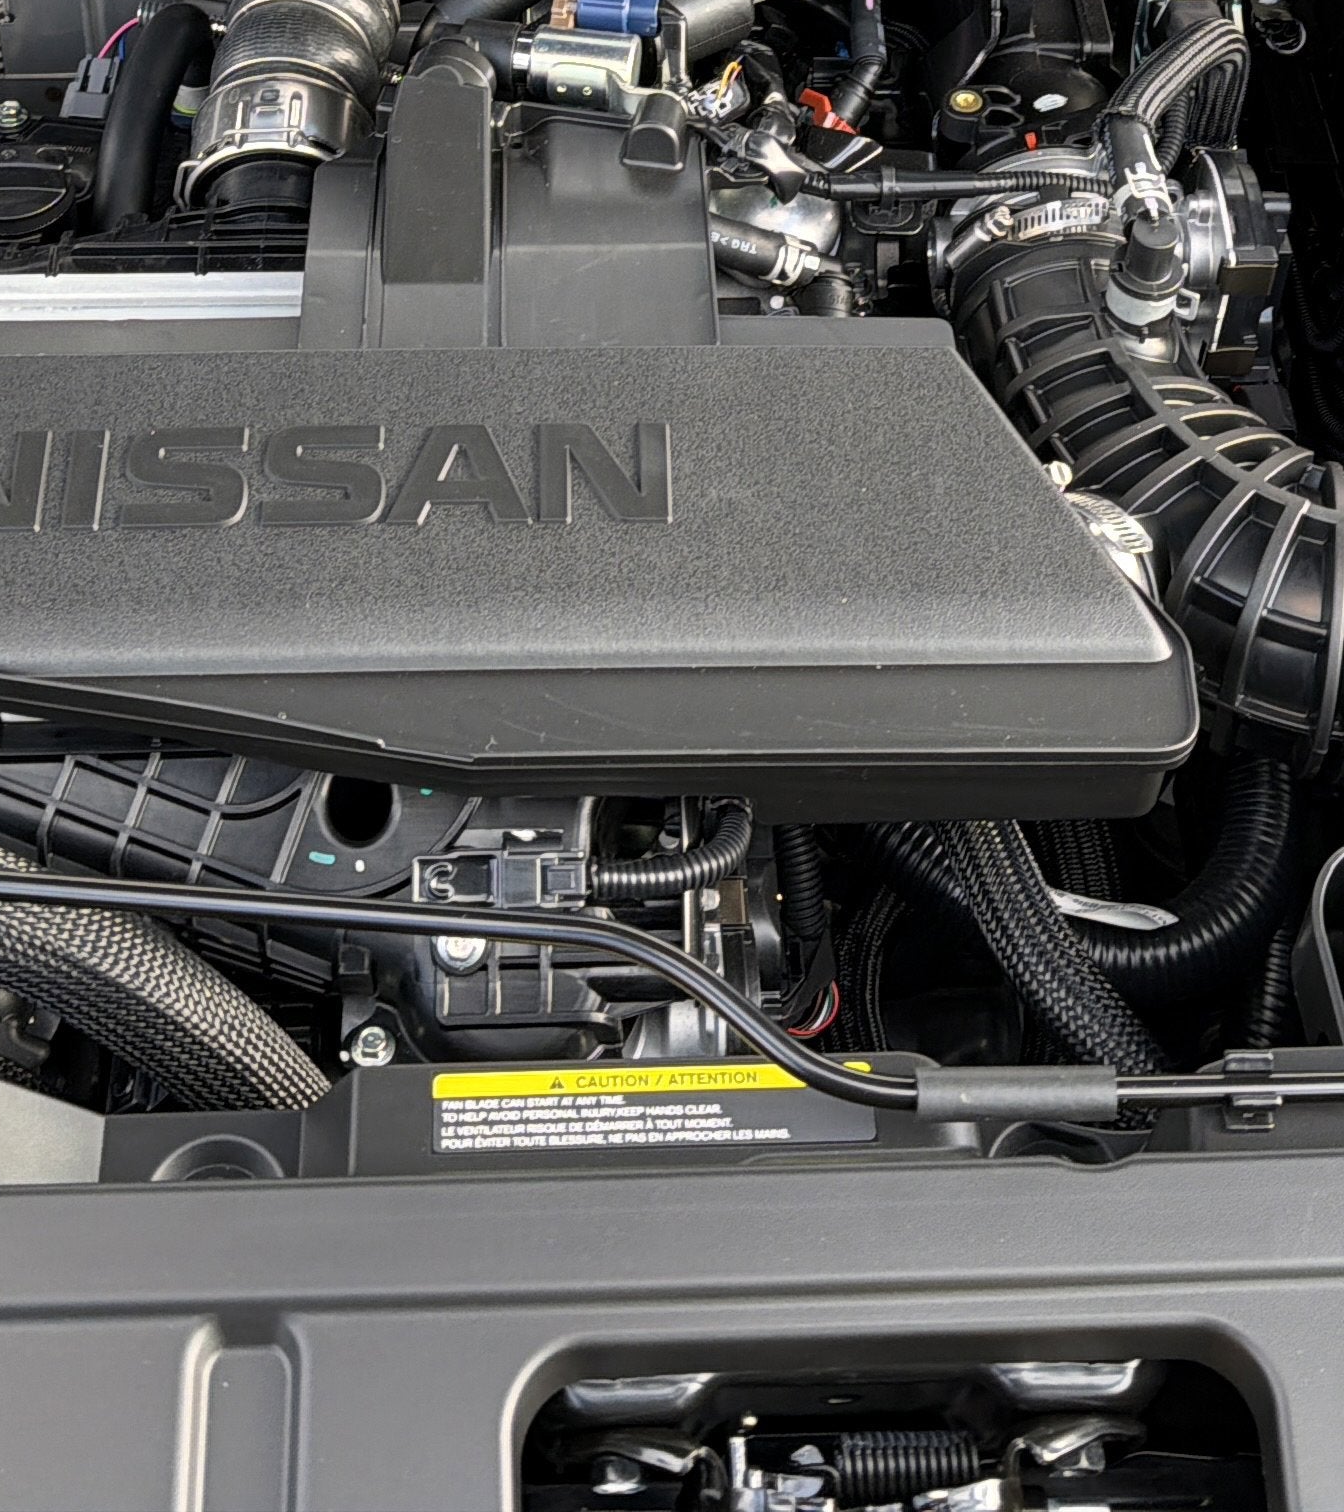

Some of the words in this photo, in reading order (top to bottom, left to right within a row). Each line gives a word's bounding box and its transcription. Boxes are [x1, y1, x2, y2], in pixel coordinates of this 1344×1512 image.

[575, 1074, 650, 1089] CAUTION
[668, 1071, 759, 1086] ATTENTION
[441, 1101, 464, 1111] FAN
[464, 1099, 500, 1110] BLADE
[500, 1098, 525, 1109] CAN
[525, 1097, 560, 1108] START
[560, 1097, 574, 1107] AT
[575, 1096, 599, 1106] ANY
[441, 1112, 458, 1123] TO
[458, 1111, 488, 1122] HELP
[488, 1110, 521, 1121] AVOID
[522, 1109, 580, 1120] PERSONAL
[646, 1104, 684, 1116] HANDS
[685, 1103, 724, 1115] CLEAR.
[441, 1126, 456, 1137] LE
[456, 1124, 526, 1137] VENTILATEUR
[526, 1122, 568, 1134] RISQUE
[568, 1121, 584, 1132] DE
[645, 1117, 654, 1130] À
[654, 1118, 684, 1129] TOUT
[441, 1138, 474, 1150] POUR
[474, 1135, 512, 1149] ÉVITER
[512, 1135, 547, 1147] TOUTE
[607, 1133, 624, 1144] NE
[625, 1132, 647, 1143] PAS
[647, 1131, 664, 1142] EN
[664, 1129, 732, 1142] APPROCHER
[732, 1129, 754, 1140] LES
